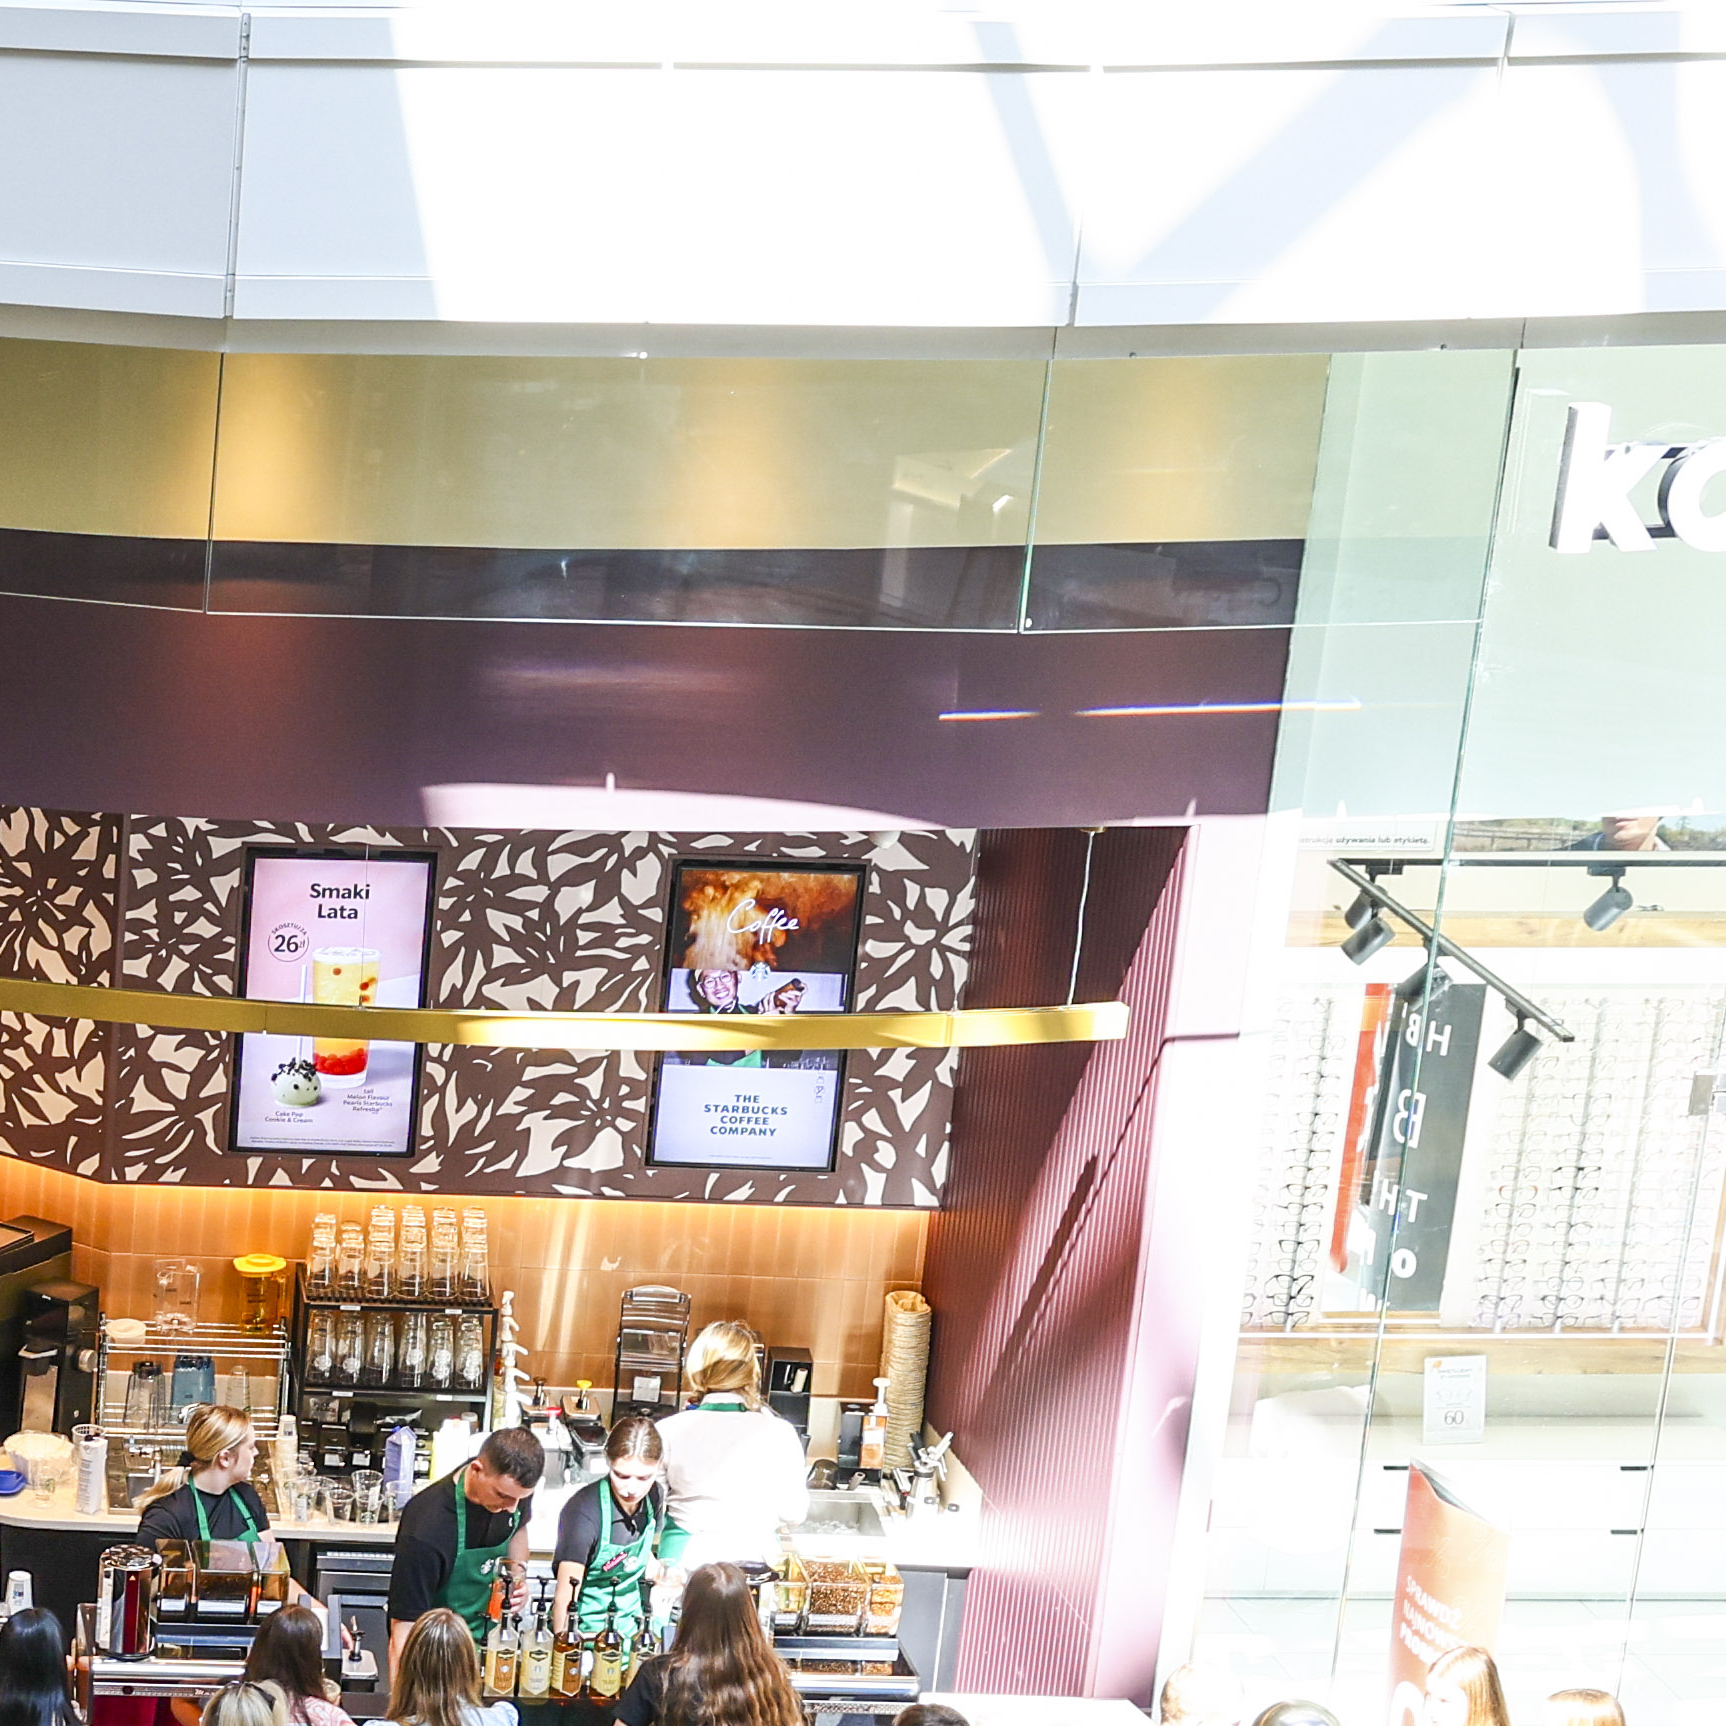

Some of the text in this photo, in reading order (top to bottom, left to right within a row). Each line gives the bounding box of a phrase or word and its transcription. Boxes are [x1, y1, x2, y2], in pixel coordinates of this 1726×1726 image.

[310, 883, 371, 900] Smaki
[317, 904, 358, 920] Lata
[727, 898, 800, 944] Coffee
[274, 934, 299, 953] 26
[734, 1094, 760, 1104] THE
[704, 1104, 788, 1116] STARBUCKS
[720, 1115, 770, 1125] COFFEE
[710, 1126, 777, 1137] COMPANY
